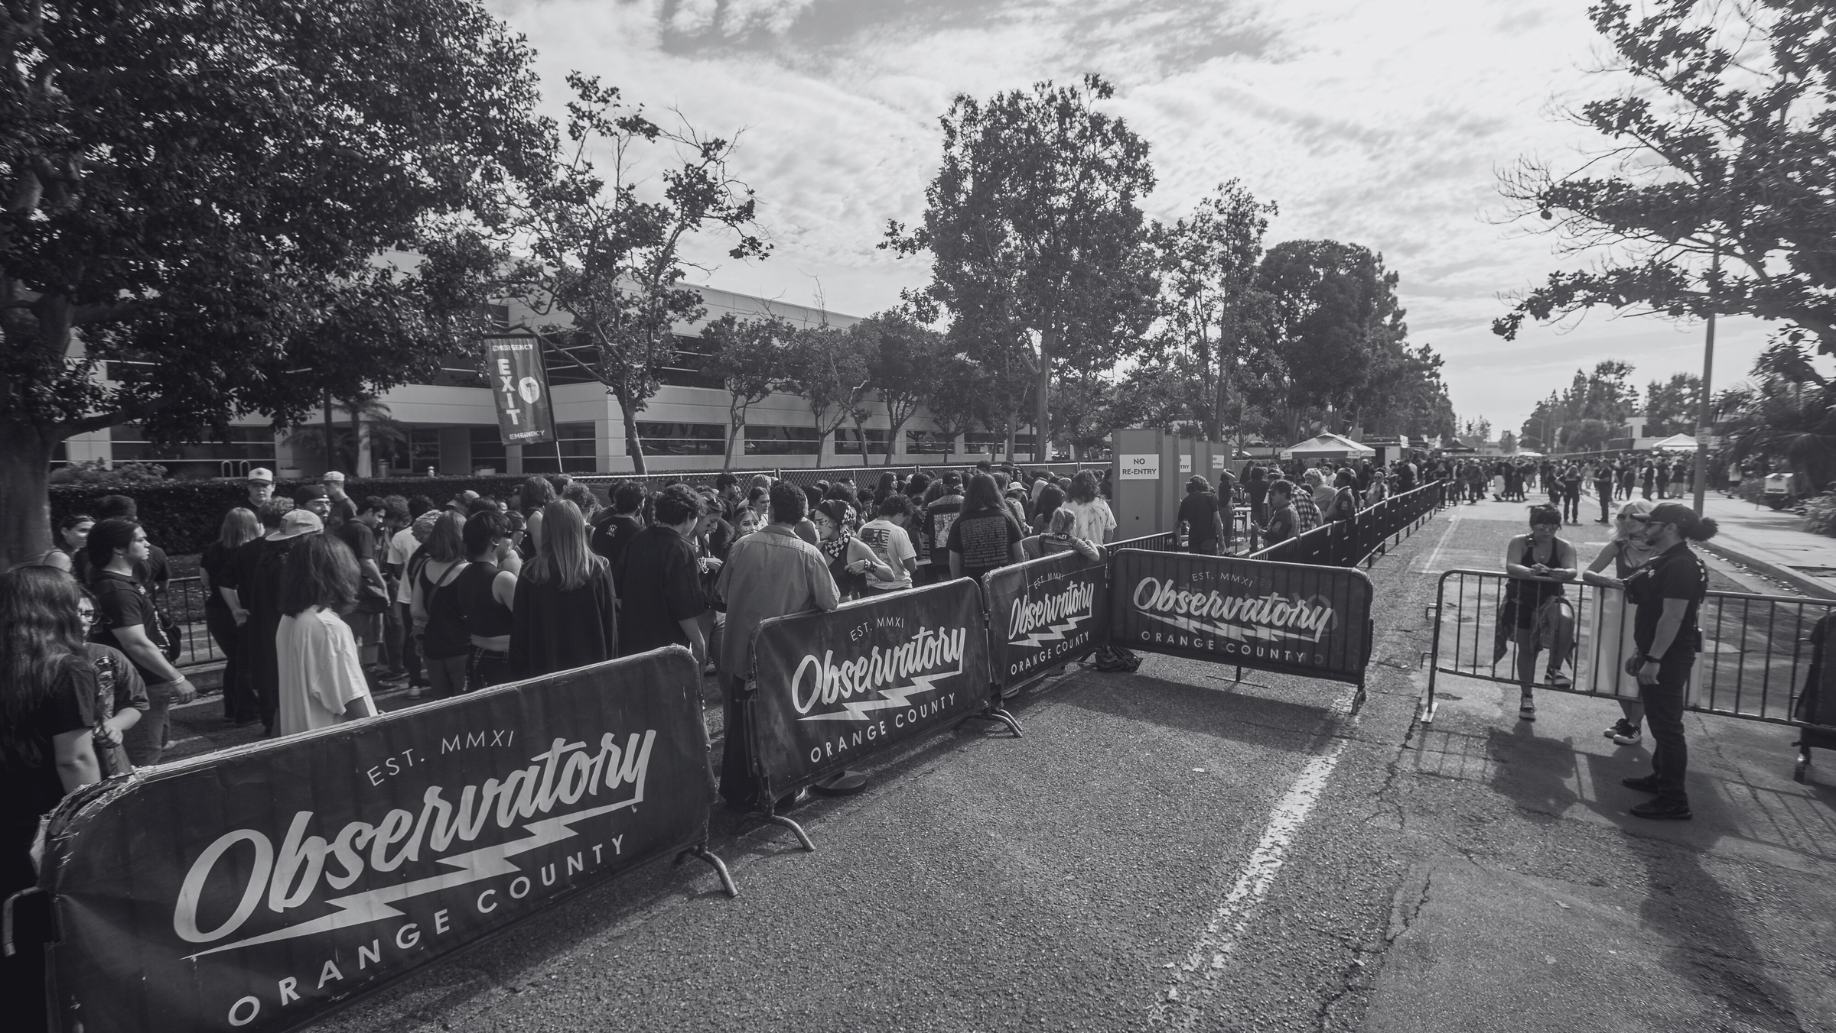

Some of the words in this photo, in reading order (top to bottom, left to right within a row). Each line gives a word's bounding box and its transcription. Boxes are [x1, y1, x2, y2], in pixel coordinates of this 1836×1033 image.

[497, 359, 520, 425] EXIT
[509, 429, 545, 440] EMERCY
[1192, 571, 1214, 583] EST.
[1220, 572, 1254, 588] MMXI
[850, 621, 873, 642] EST.
[876, 616, 905, 629] MMXI
[1008, 580, 1094, 640] Observatory
[1134, 577, 1333, 643] Observatory
[791, 626, 966, 714] Observatory
[1010, 648, 1052, 675] ORANGE
[1055, 631, 1090, 655] COUNTY
[1141, 631, 1214, 650] ORANGE
[1225, 642, 1305, 663] COUNTY
[810, 720, 887, 763] ORANGE
[895, 692, 956, 729] COUNTY
[367, 747, 425, 787] EST.
[441, 729, 515, 755] MMXI
[173, 729, 656, 943] Observatory
[228, 908, 449, 1027] ORANGE
[477, 833, 626, 914] COUNTY
